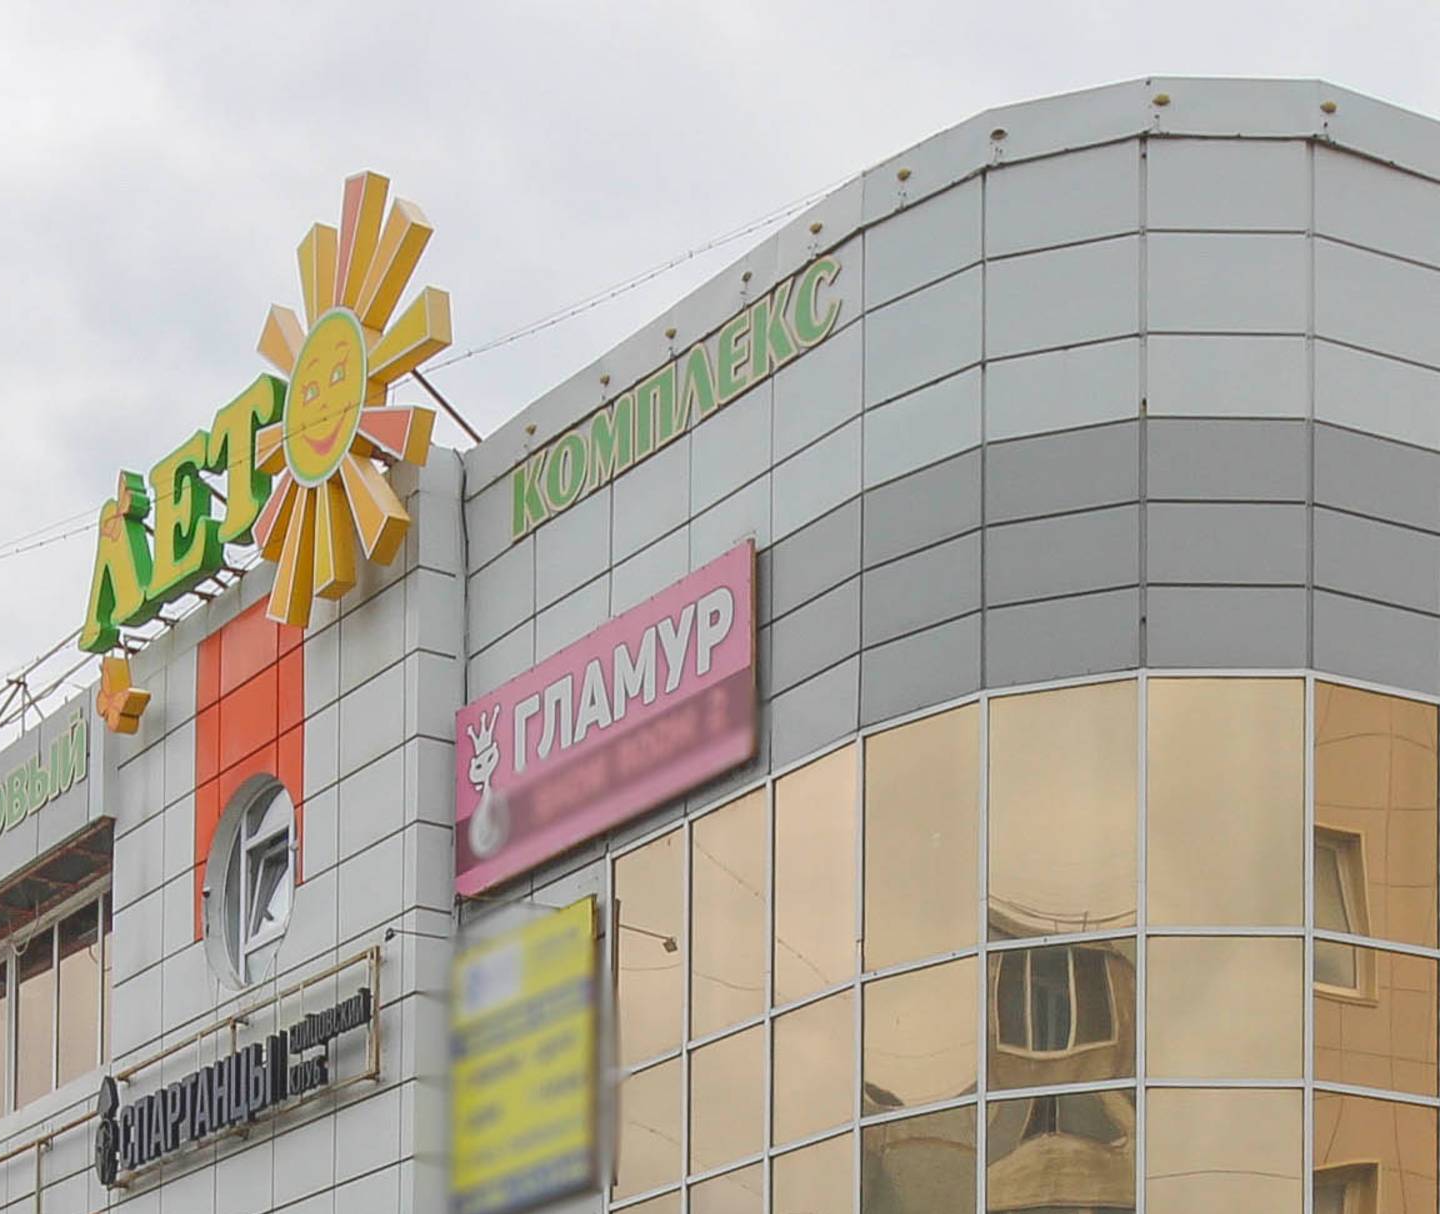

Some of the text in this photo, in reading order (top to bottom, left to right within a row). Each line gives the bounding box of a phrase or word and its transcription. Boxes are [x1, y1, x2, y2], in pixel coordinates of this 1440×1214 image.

[511, 254, 844, 546] КОМПЛЕКС
[512, 584, 736, 775] ГЛАМУР
[119, 1030, 288, 1172] СПАРТАНЦЫ
[289, 1055, 328, 1096] КЛУБ
